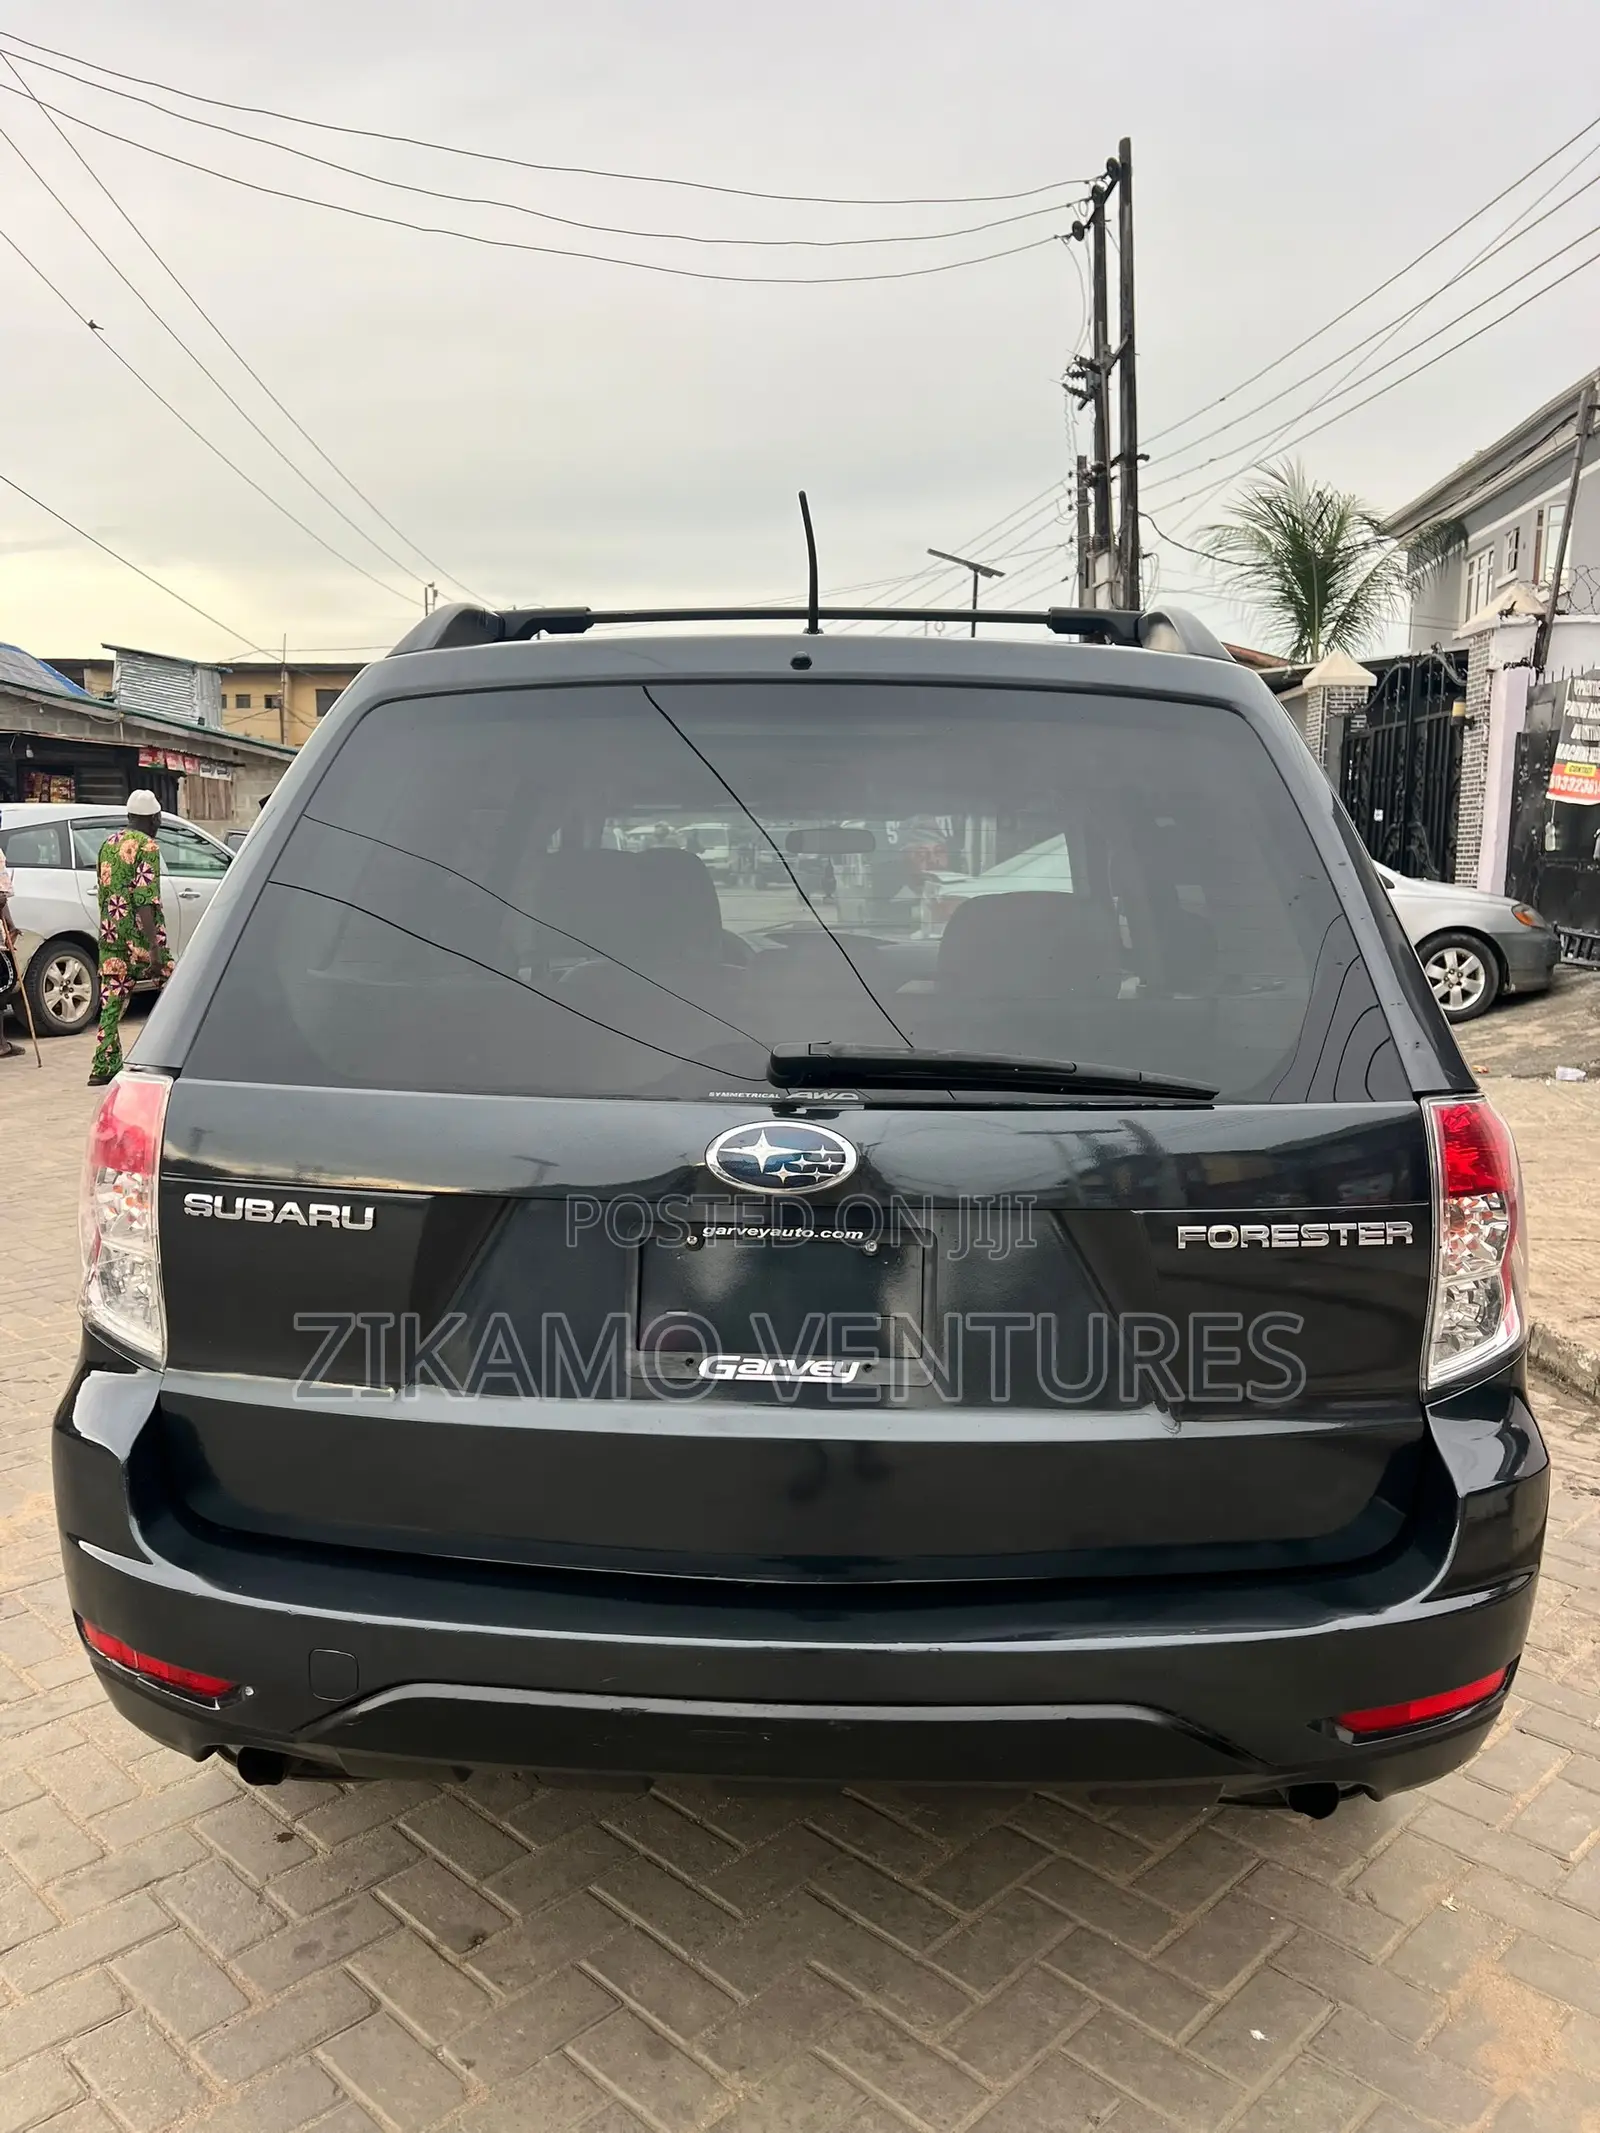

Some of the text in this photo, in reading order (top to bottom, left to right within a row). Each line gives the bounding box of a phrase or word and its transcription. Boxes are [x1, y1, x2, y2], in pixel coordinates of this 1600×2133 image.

[708, 1091, 860, 1100] SYMMETRICAL AWD
[184, 1193, 375, 1231] SUBARU
[702, 1226, 864, 1240] garveyauto.com
[1177, 1221, 1414, 1250] FORESTER
[698, 1355, 861, 1384] Garvey
